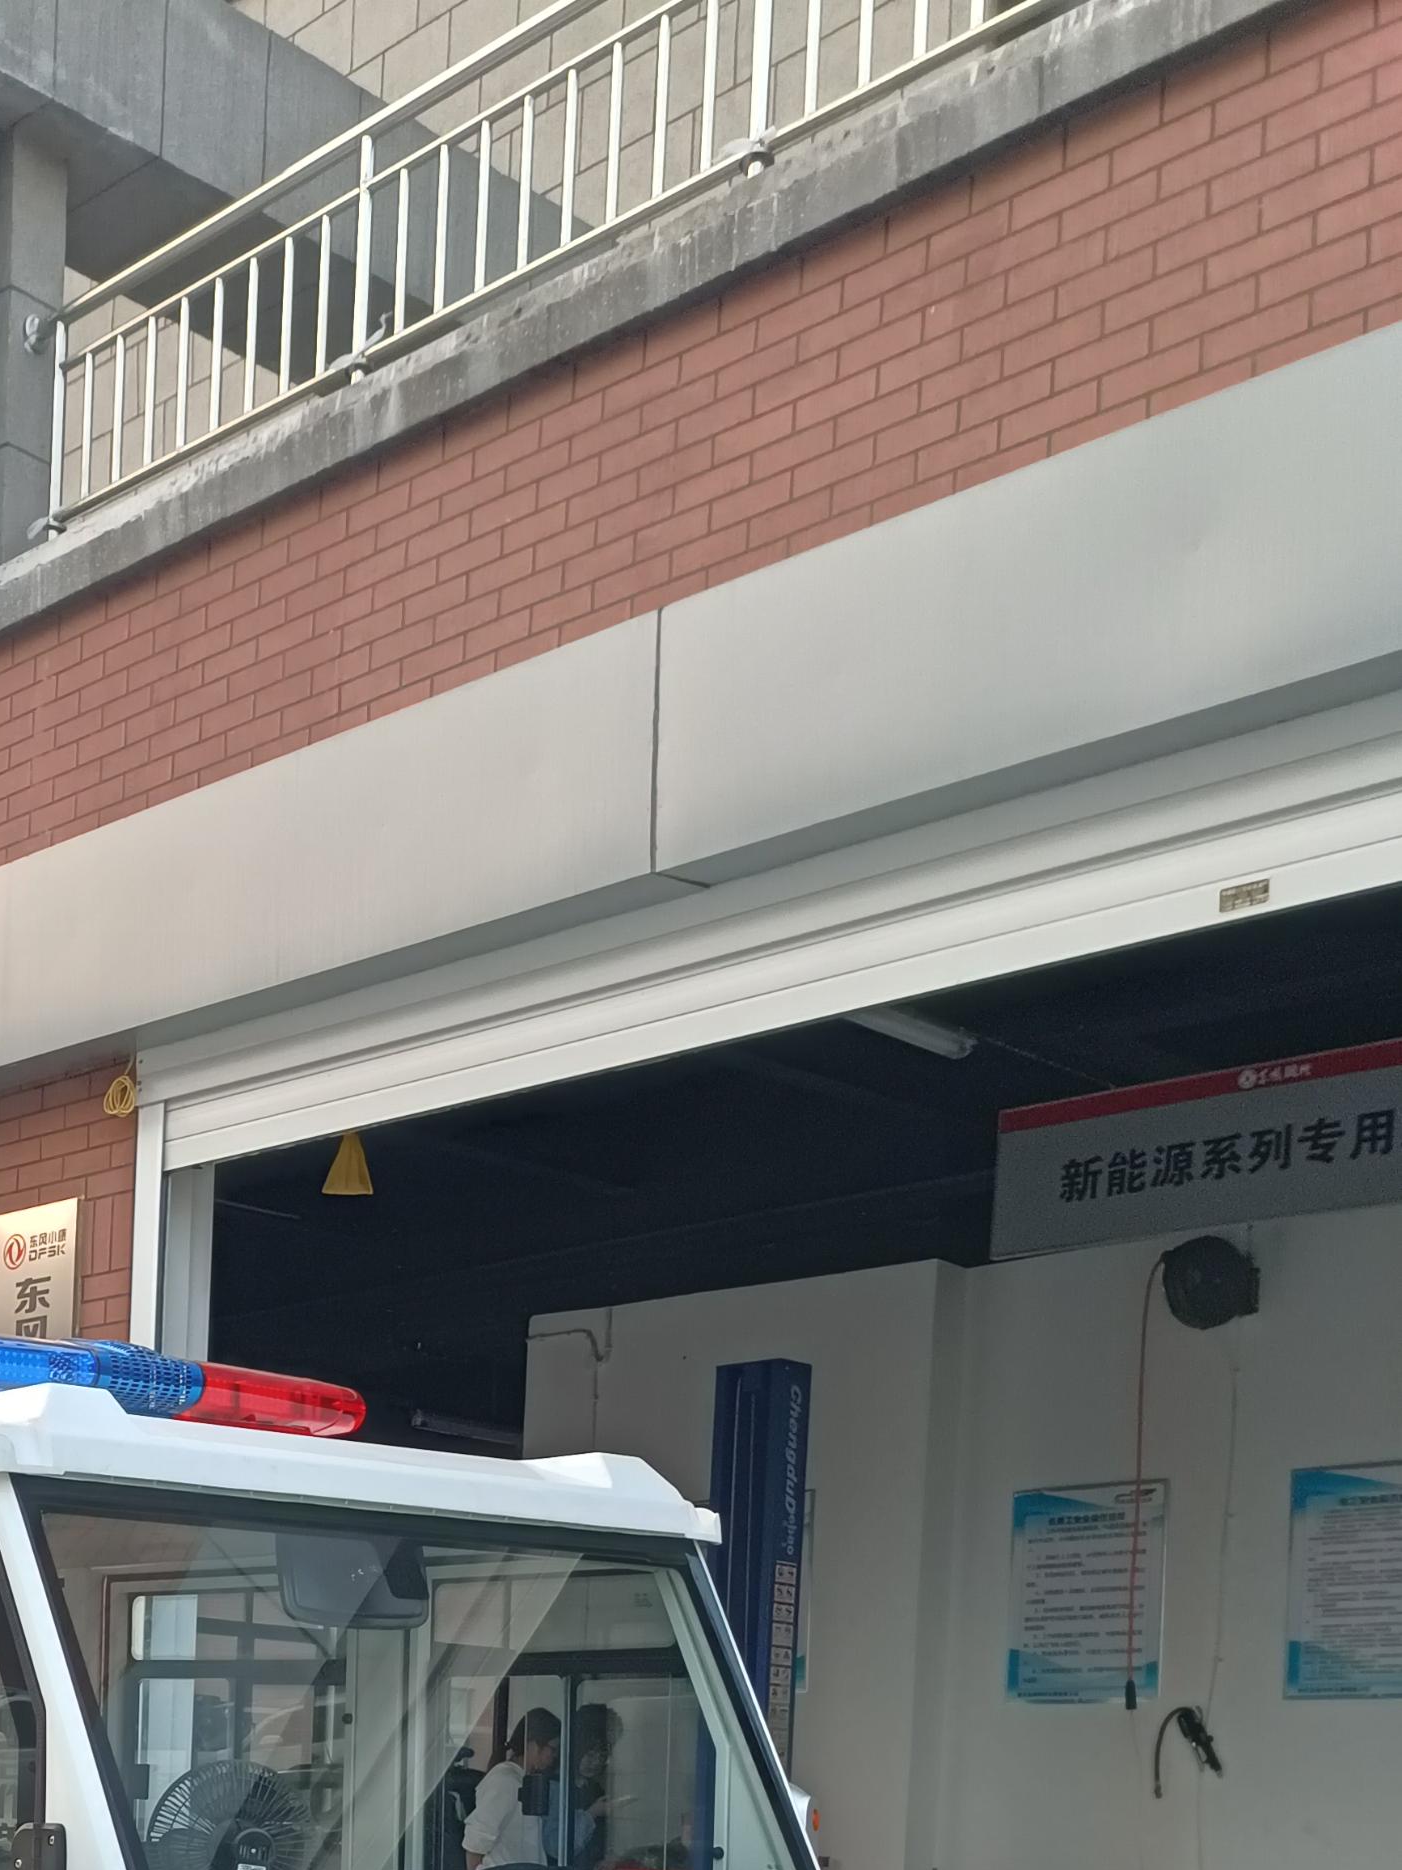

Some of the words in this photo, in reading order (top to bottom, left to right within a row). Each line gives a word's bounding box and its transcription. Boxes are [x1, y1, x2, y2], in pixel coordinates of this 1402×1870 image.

[1058, 1108, 1396, 1203] 新能源系列专用
[29, 1244, 65, 1261] DFSK
